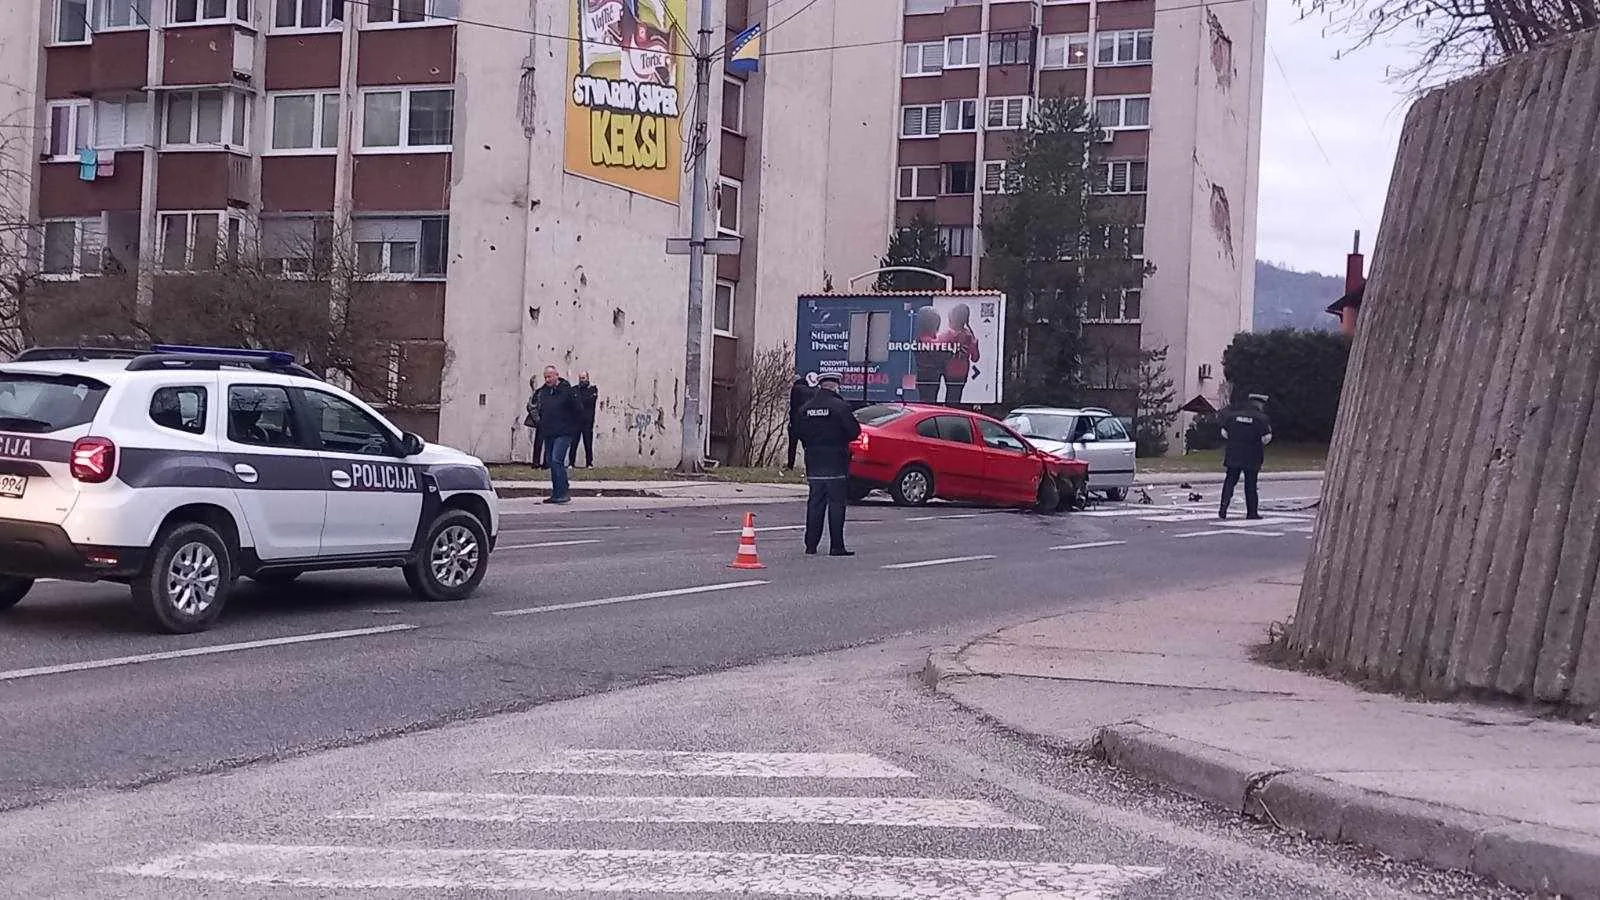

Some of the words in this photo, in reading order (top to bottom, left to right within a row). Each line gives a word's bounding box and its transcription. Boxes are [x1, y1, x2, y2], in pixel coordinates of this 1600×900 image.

[639, 83, 678, 115] SUPER
[592, 110, 666, 168] KEKSI
[351, 463, 417, 490] POLICIJA
